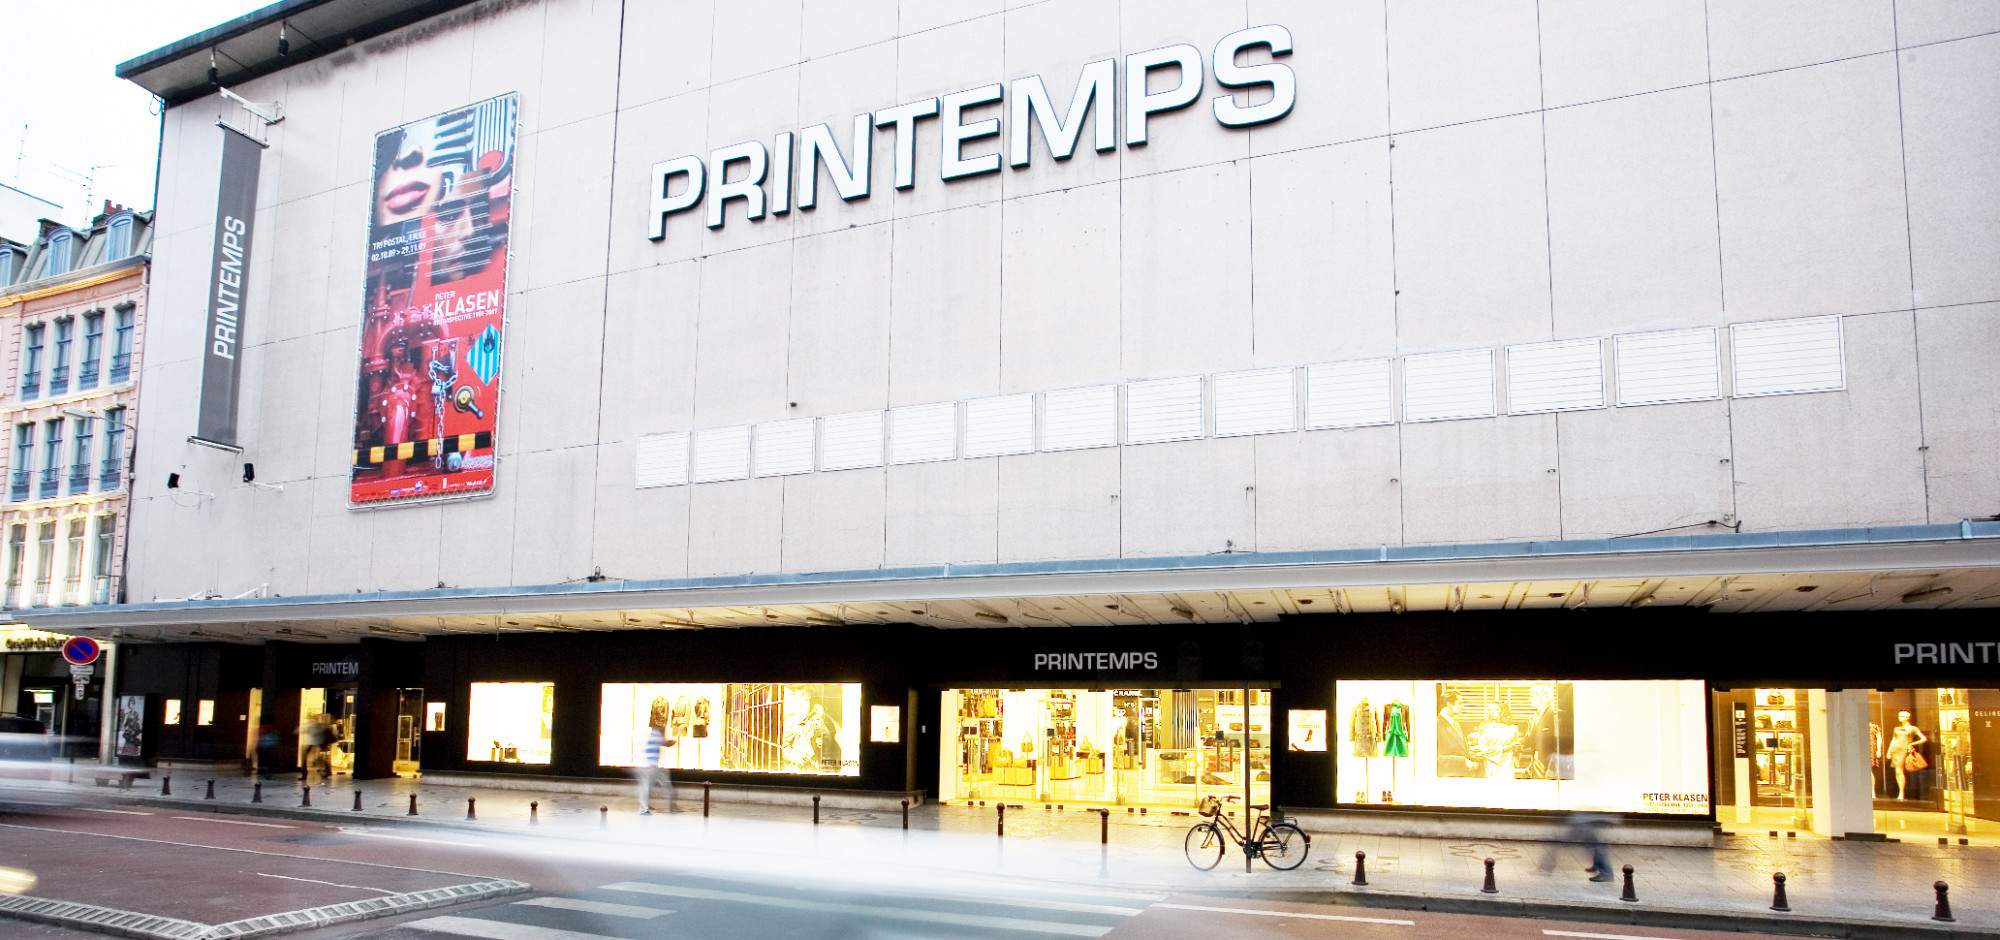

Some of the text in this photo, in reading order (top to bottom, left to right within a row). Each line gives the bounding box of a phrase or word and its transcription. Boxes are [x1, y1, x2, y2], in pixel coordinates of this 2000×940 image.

[648, 23, 1297, 242] PRINTEMPS
[213, 215, 246, 360] PRINTEMPS
[435, 290, 456, 301] PETER
[433, 289, 499, 320] KLASEN
[1034, 652, 1158, 670] PRINTEMPS
[1894, 642, 2000, 664] PRINT
[1642, 793, 1708, 802] PETER KLASEN
